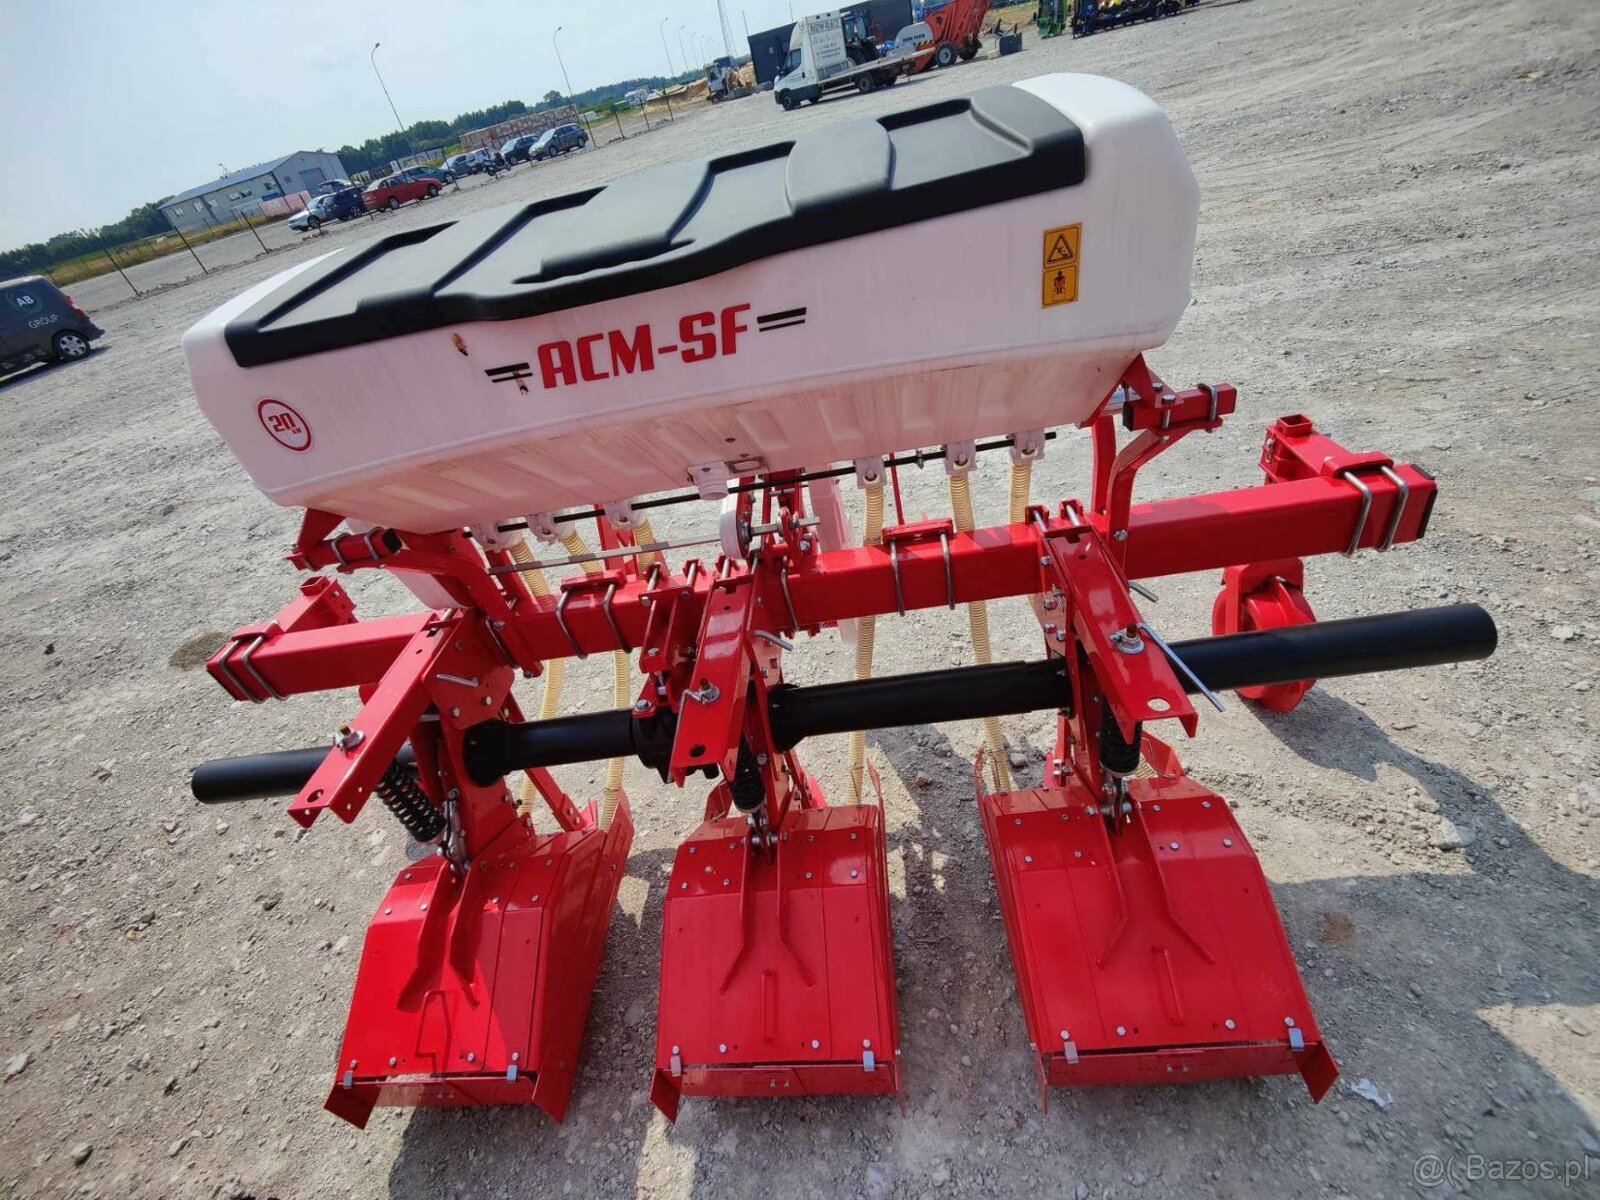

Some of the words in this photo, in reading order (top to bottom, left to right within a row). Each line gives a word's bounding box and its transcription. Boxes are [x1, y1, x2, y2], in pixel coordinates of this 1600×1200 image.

[16, 295, 34, 307] AB
[28, 314, 58, 329] GROUP
[537, 302, 752, 389] ACM-SF
